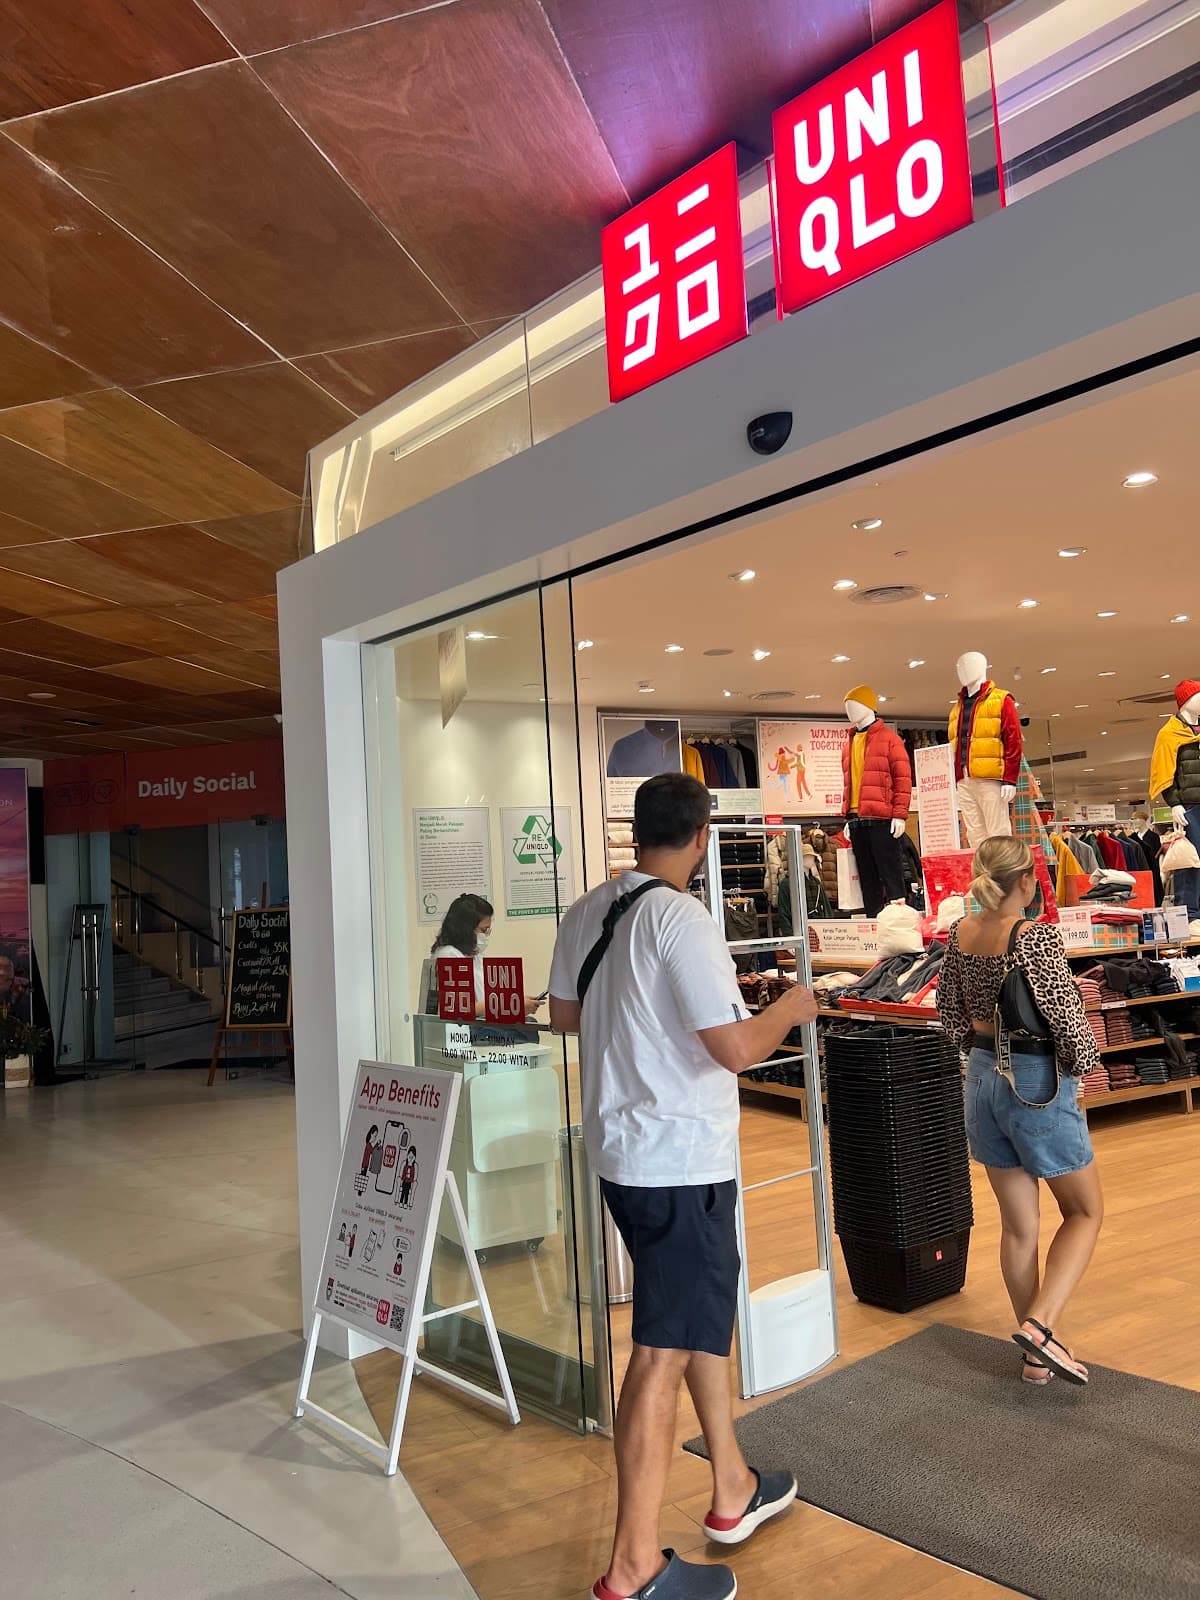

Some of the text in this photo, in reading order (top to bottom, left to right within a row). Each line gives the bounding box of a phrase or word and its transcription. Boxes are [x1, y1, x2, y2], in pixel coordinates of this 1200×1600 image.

[793, 49, 924, 185] UNI
[800, 138, 944, 276] QLO
[810, 740, 842, 751] TOGETH
[138, 771, 256, 799] Daily Social
[526, 843, 549, 851] UNIQLO
[239, 912, 288, 931] Daily Social
[1068, 930, 1089, 940] 199.000
[487, 965, 517, 989] UNI
[488, 992, 521, 1020] QLO
[450, 1032, 478, 1044] MONDAY
[441, 1047, 458, 1059] 10.00
[460, 1049, 478, 1062] WITA
[488, 1052, 507, 1064] 22.00
[509, 1055, 529, 1067] WITA
[360, 1075, 441, 1109] App Benefits
